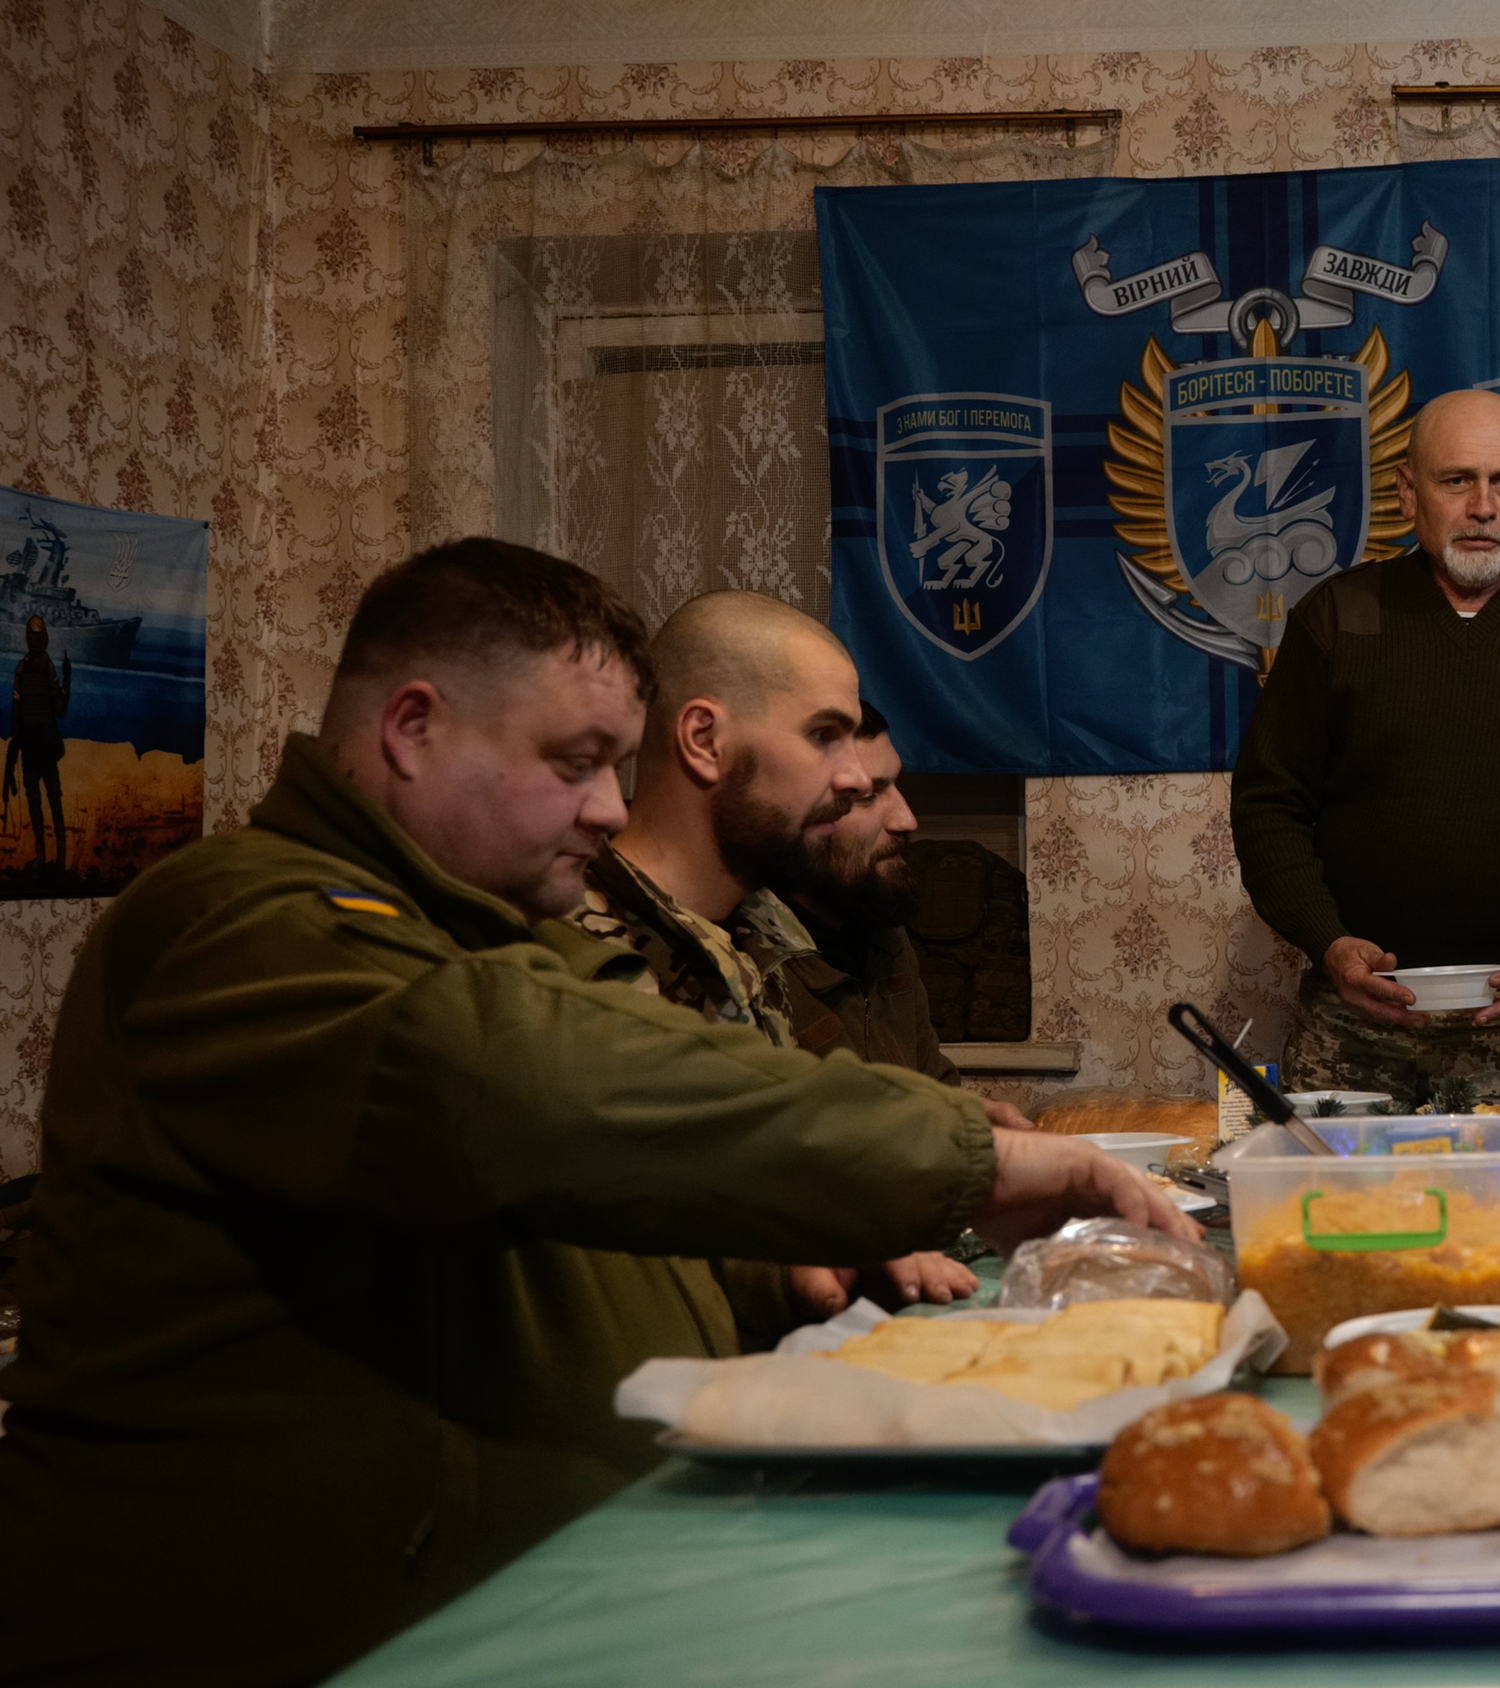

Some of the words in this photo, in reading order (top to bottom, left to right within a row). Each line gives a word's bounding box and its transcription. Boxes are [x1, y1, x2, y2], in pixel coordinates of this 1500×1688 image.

[1112, 256, 1201, 308] ВІРНИЙ
[1323, 252, 1413, 296] ЗАВЖДИ
[1177, 370, 1255, 406] БОРІТЕСЯ
[1270, 369, 1354, 398] ПОБОРЕТЕ
[904, 411, 936, 431] НАМИ
[939, 409, 961, 426] БОГ
[971, 410, 1032, 432] ПЕРЕМОГА
